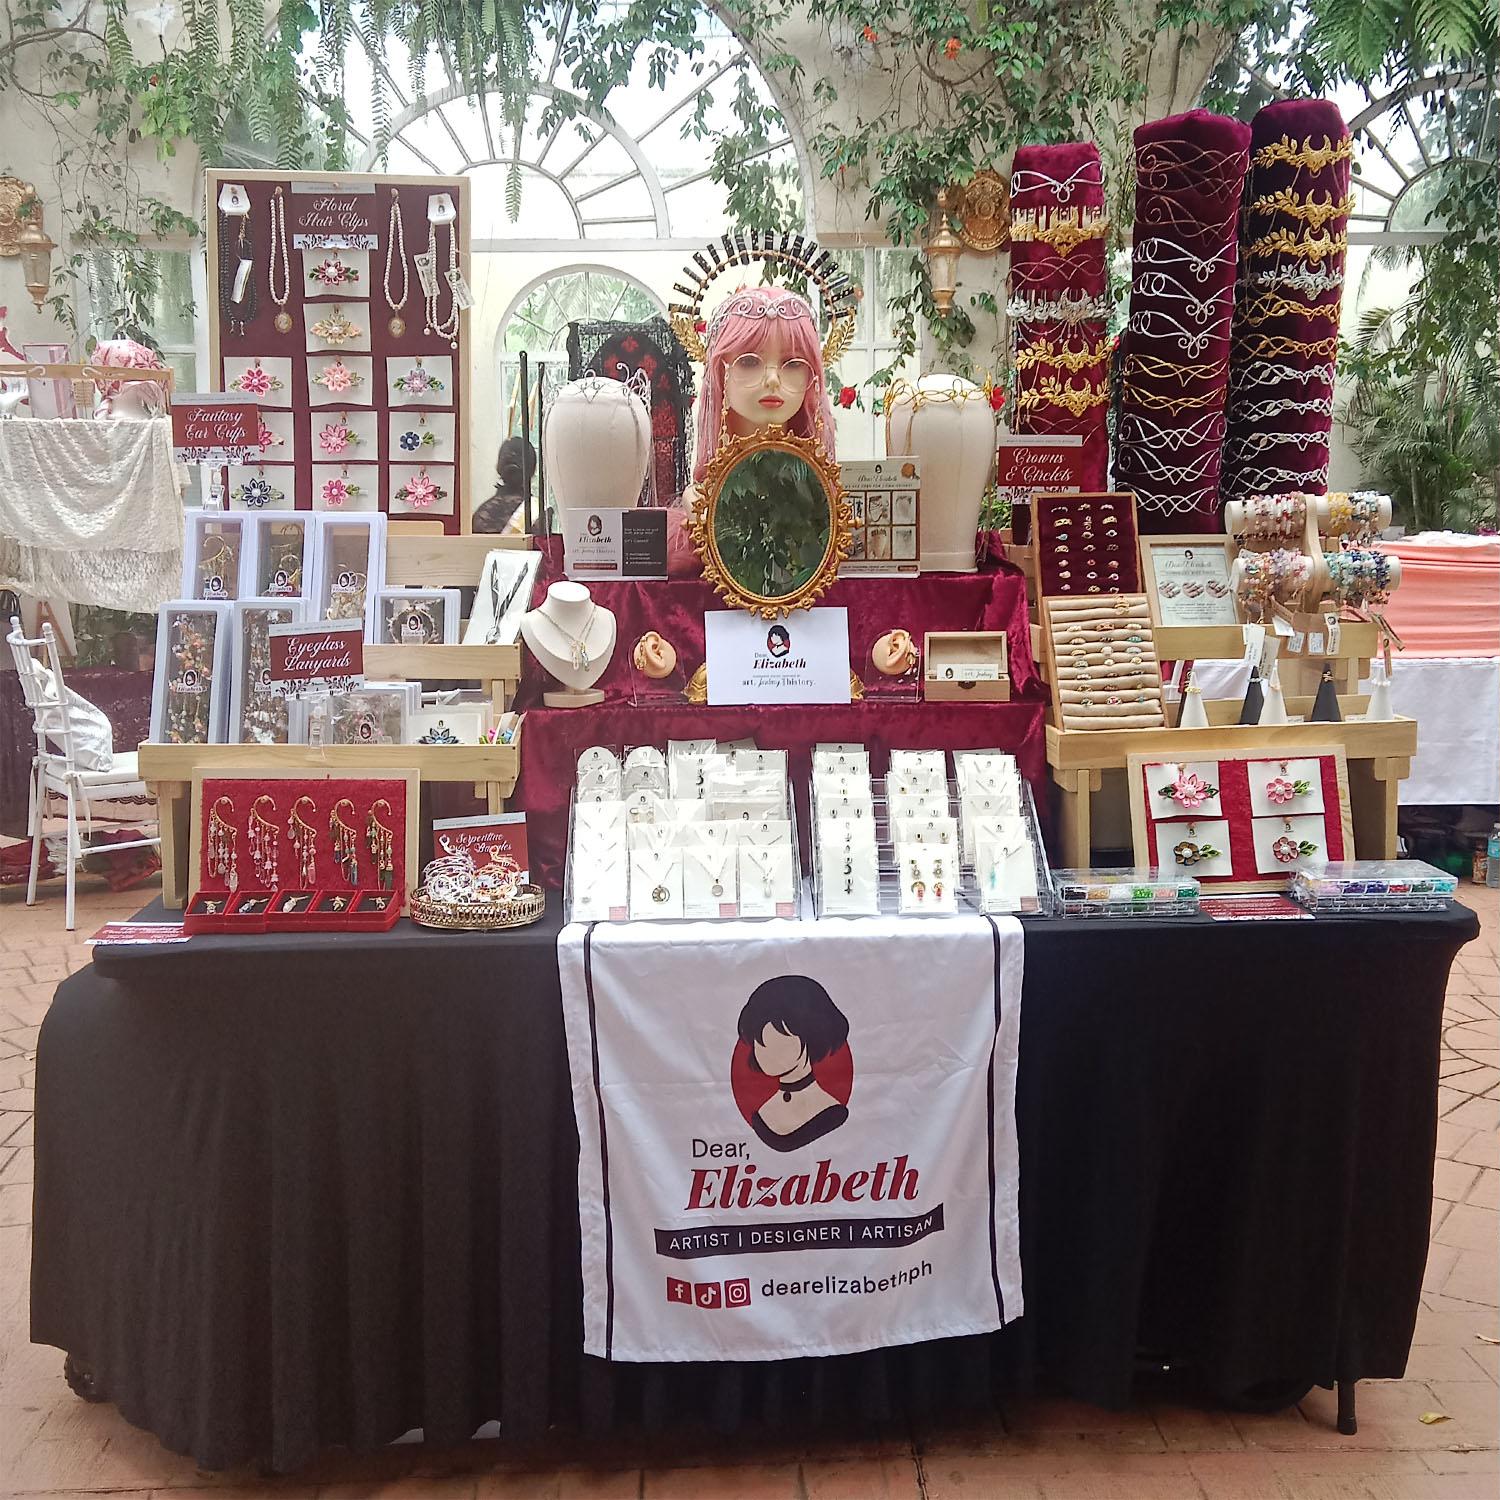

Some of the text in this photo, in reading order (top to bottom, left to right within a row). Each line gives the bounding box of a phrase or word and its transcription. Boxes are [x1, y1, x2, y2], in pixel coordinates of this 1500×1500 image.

[313, 197, 357, 211] Floral
[299, 212, 368, 232] Hair Clips
[187, 408, 243, 426] Fantasy
[185, 424, 247, 444] Ear Cuffs
[1013, 448, 1066, 466] Crowns
[1006, 466, 1073, 484] & Circlets
[288, 636, 346, 658] Eyeglass
[284, 651, 351, 676] Lanyards
[753, 658, 807, 669] Elizabeth
[456, 832, 504, 848] Serpentine
[692, 1138, 750, 1160] Dear,
[684, 1154, 919, 1211] Elizabeth
[669, 1233, 730, 1250] ARTIST
[751, 1227, 841, 1246] DESIGNER
[861, 1215, 933, 1239] ARTISAN
[761, 1260, 933, 1297] dearelizabethph
